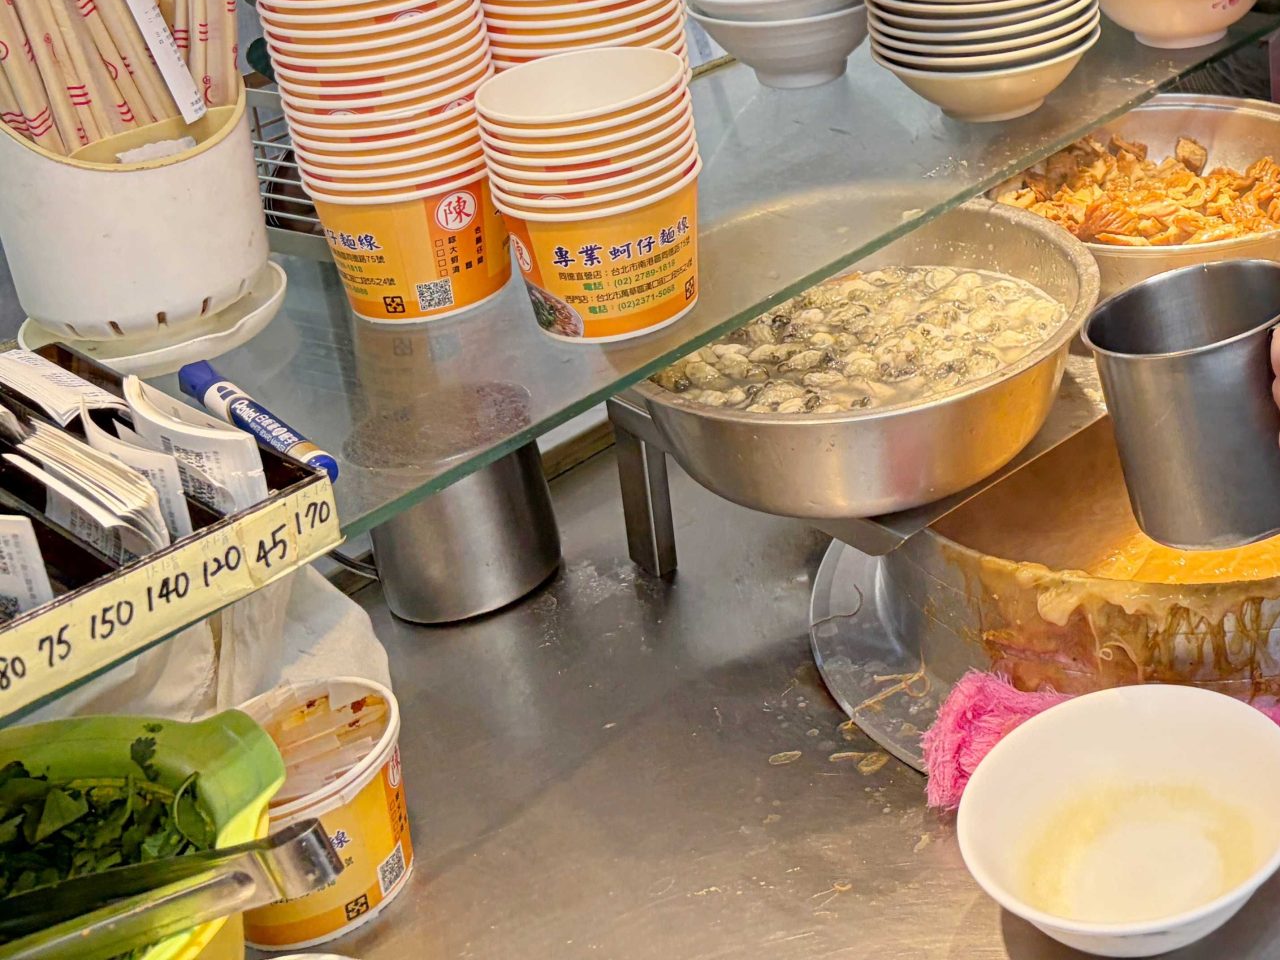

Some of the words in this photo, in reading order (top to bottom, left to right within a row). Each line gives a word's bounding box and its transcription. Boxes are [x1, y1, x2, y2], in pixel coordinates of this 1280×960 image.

[442, 195, 473, 227] 陳
[553, 216, 690, 268] 專業蚵仔麵線
[231, 400, 260, 423] Pentel
[38, 624, 72, 667] 75
[90, 599, 135, 640] 150
[147, 571, 190, 613] 140
[203, 544, 242, 588] 120
[255, 523, 288, 568] 45
[295, 499, 331, 536] 170
